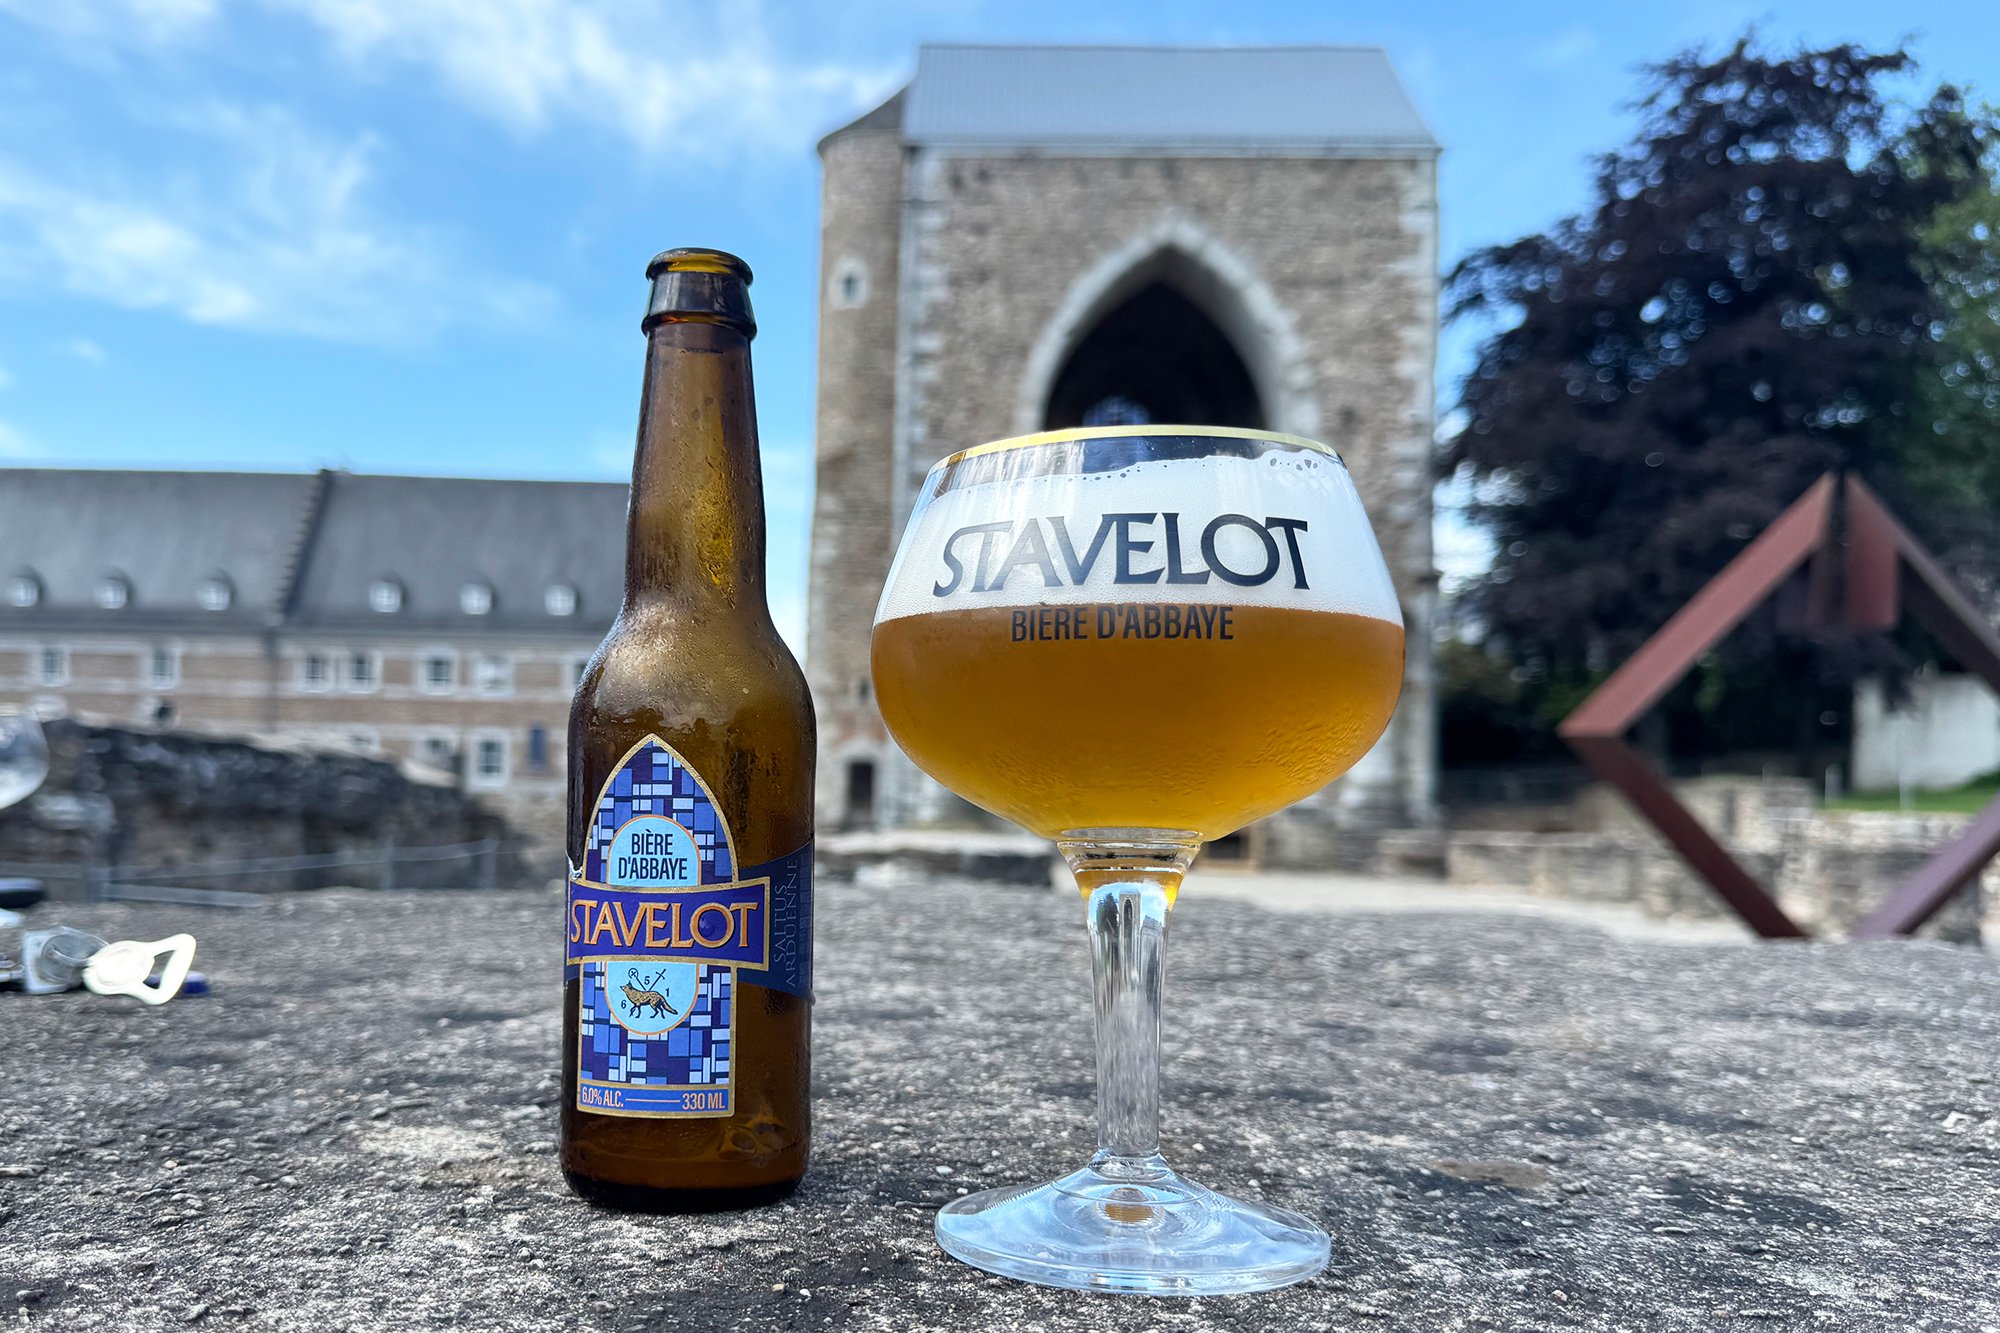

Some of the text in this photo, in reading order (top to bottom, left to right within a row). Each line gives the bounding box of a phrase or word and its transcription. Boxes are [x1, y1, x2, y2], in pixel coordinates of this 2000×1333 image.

[932, 511, 1311, 598] STAVELOT
[1011, 601, 1234, 643] BIÈRE D'ABBAYE
[631, 828, 674, 856] BIÈRE
[618, 856, 688, 880] D'ABBAYE
[570, 898, 759, 949] STAVELOT
[773, 884, 788, 963] SALTUS
[785, 859, 798, 987] ARDUENNE
[620, 999, 627, 1010] 6
[643, 975, 651, 986] 5
[582, 1086, 726, 1110] 6.0% ALC. 330 ML
